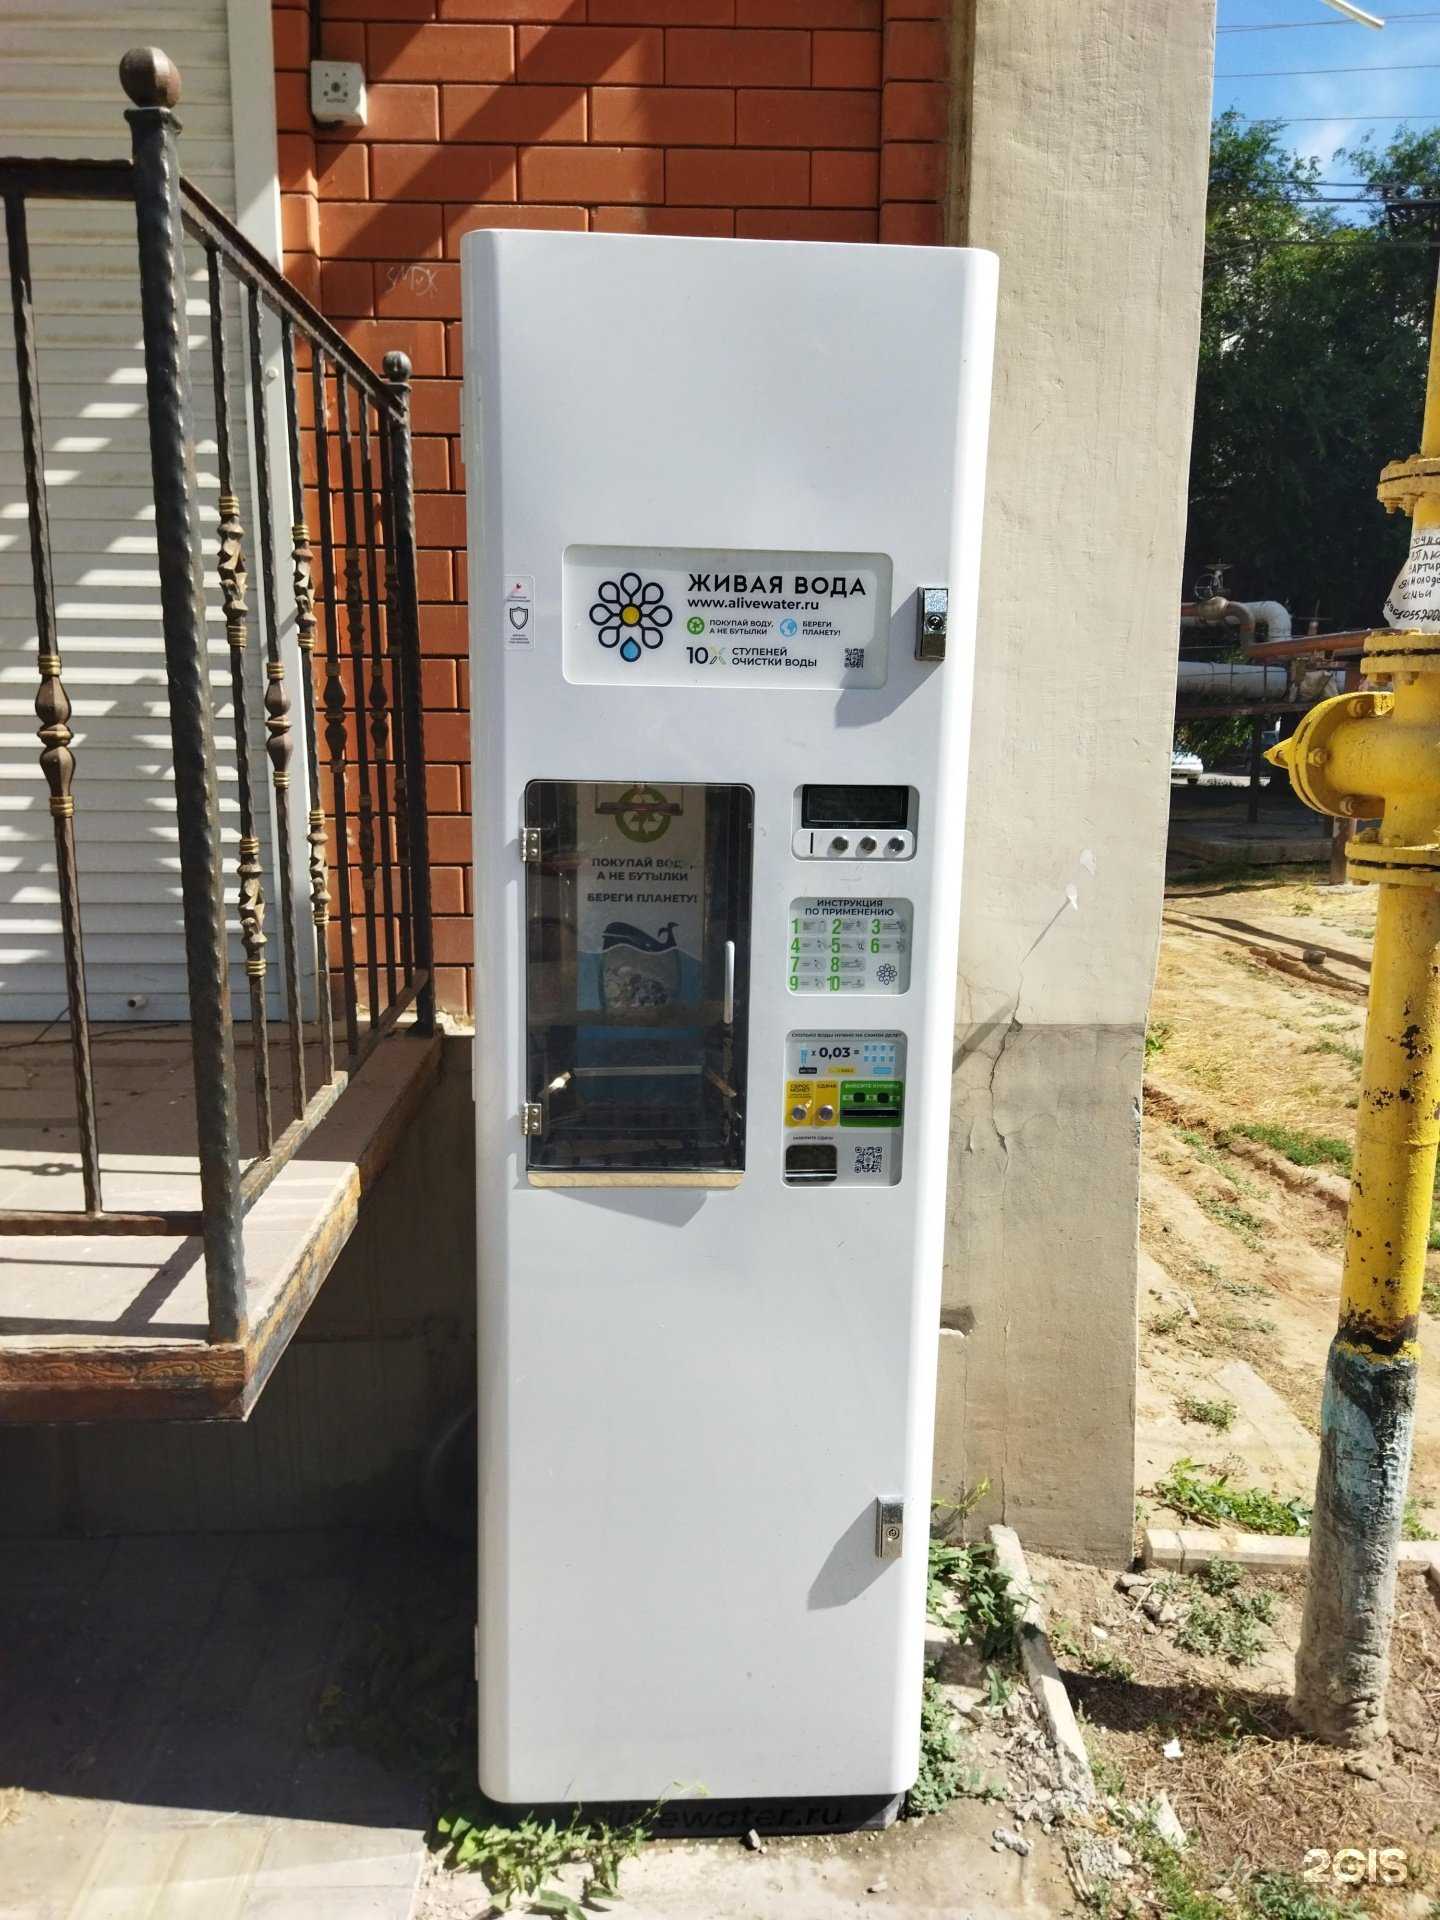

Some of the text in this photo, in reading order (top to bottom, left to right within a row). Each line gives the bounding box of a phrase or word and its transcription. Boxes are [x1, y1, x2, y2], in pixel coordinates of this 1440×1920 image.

[687, 573, 866, 598] ЖИВАЯ ВОДА
[687, 597, 819, 610] www.alivewater.ru
[709, 619, 748, 627] ПОКУПАЙ
[750, 620, 774, 628] ВОДУ,
[732, 646, 787, 656] СТУПЕНЕЙ
[732, 657, 817, 667] ОЧИСТКИ ВОДЫ
[591, 856, 653, 868] ПОКУПАЙ
[596, 872, 688, 882] А НЕ БУТЫЛКИ
[587, 893, 698, 904] БЕРЕГИ ПЛАНЕТУ!
[817, 899, 883, 907] ИНСТРУКЦИЯ
[822, 908, 895, 916] ПРИМЕНЕНИЮ
[791, 919, 799, 934] 1
[832, 919, 842, 935] 2
[871, 919, 881, 935] 3
[790, 937, 800, 953] 4
[831, 937, 840, 954] 5
[870, 938, 880, 954] 6
[790, 957, 800, 972] 7
[830, 956, 840, 972] 8
[789, 975, 799, 991] 9
[827, 975, 840, 991] 10
[819, 1047, 850, 1060] 0,03
